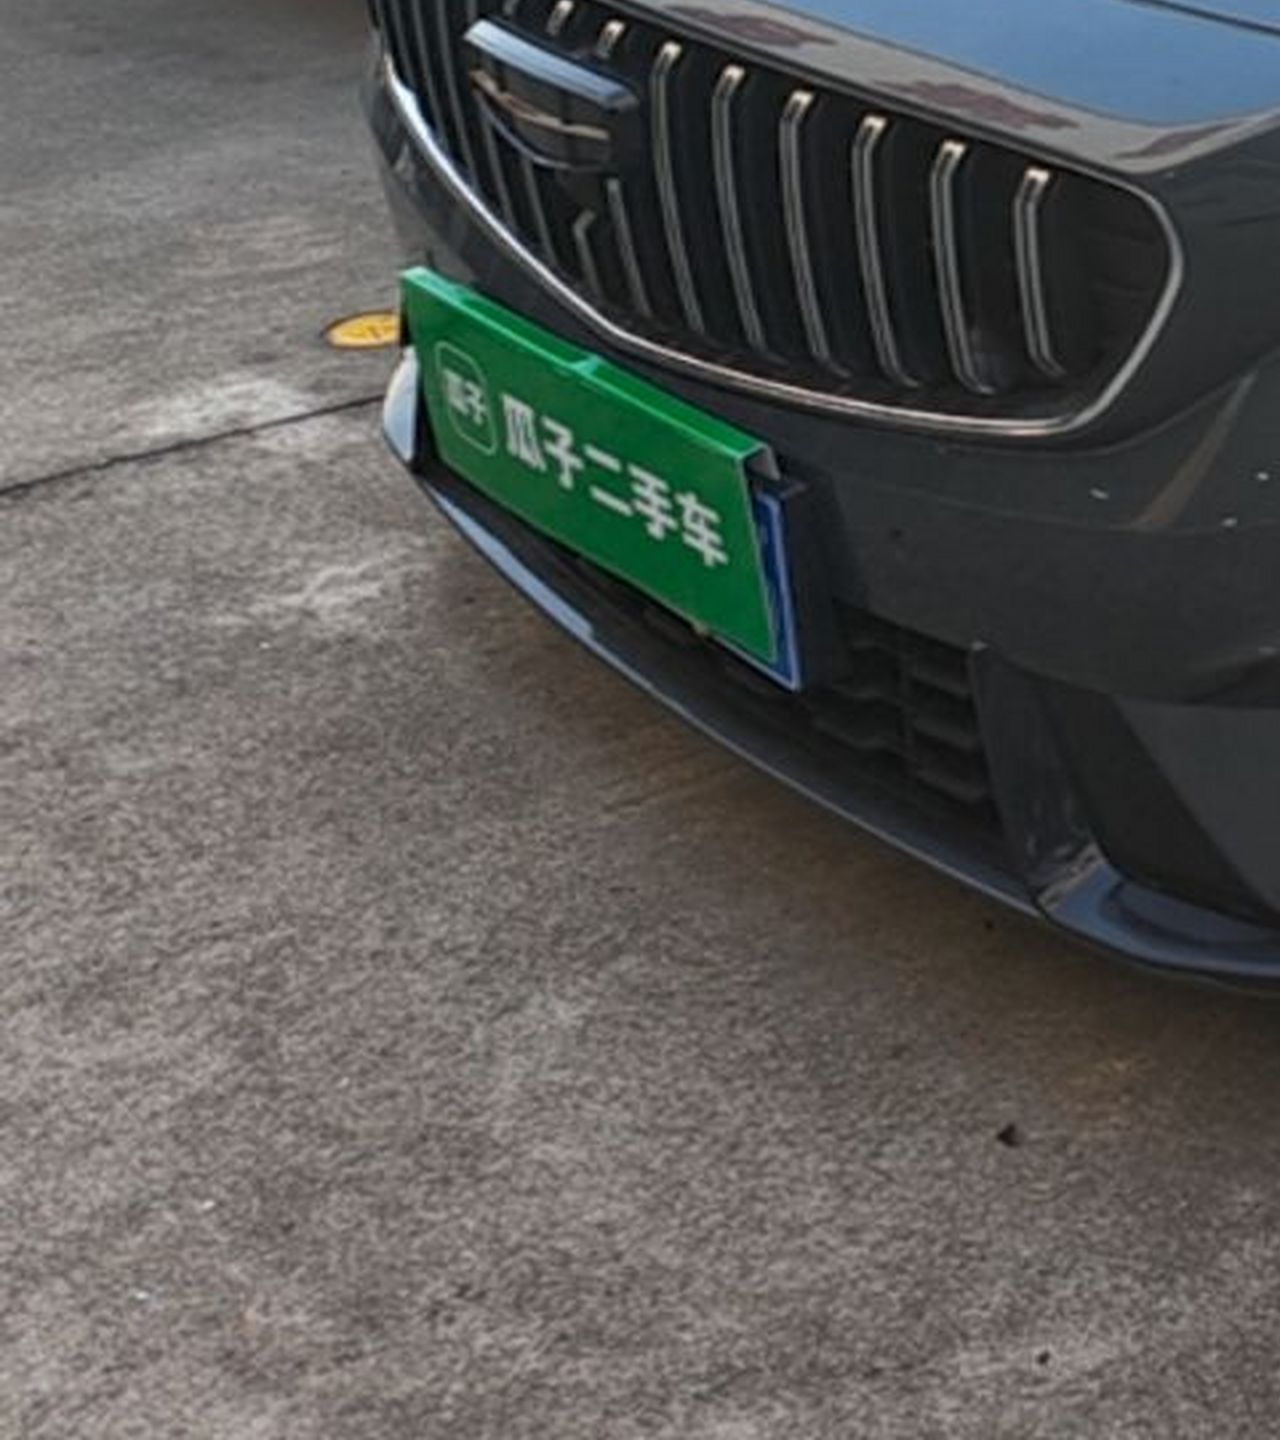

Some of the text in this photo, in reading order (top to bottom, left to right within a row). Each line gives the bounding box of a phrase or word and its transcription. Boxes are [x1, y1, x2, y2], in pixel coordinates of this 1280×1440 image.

[502, 394, 728, 566] 瓜子二手车
